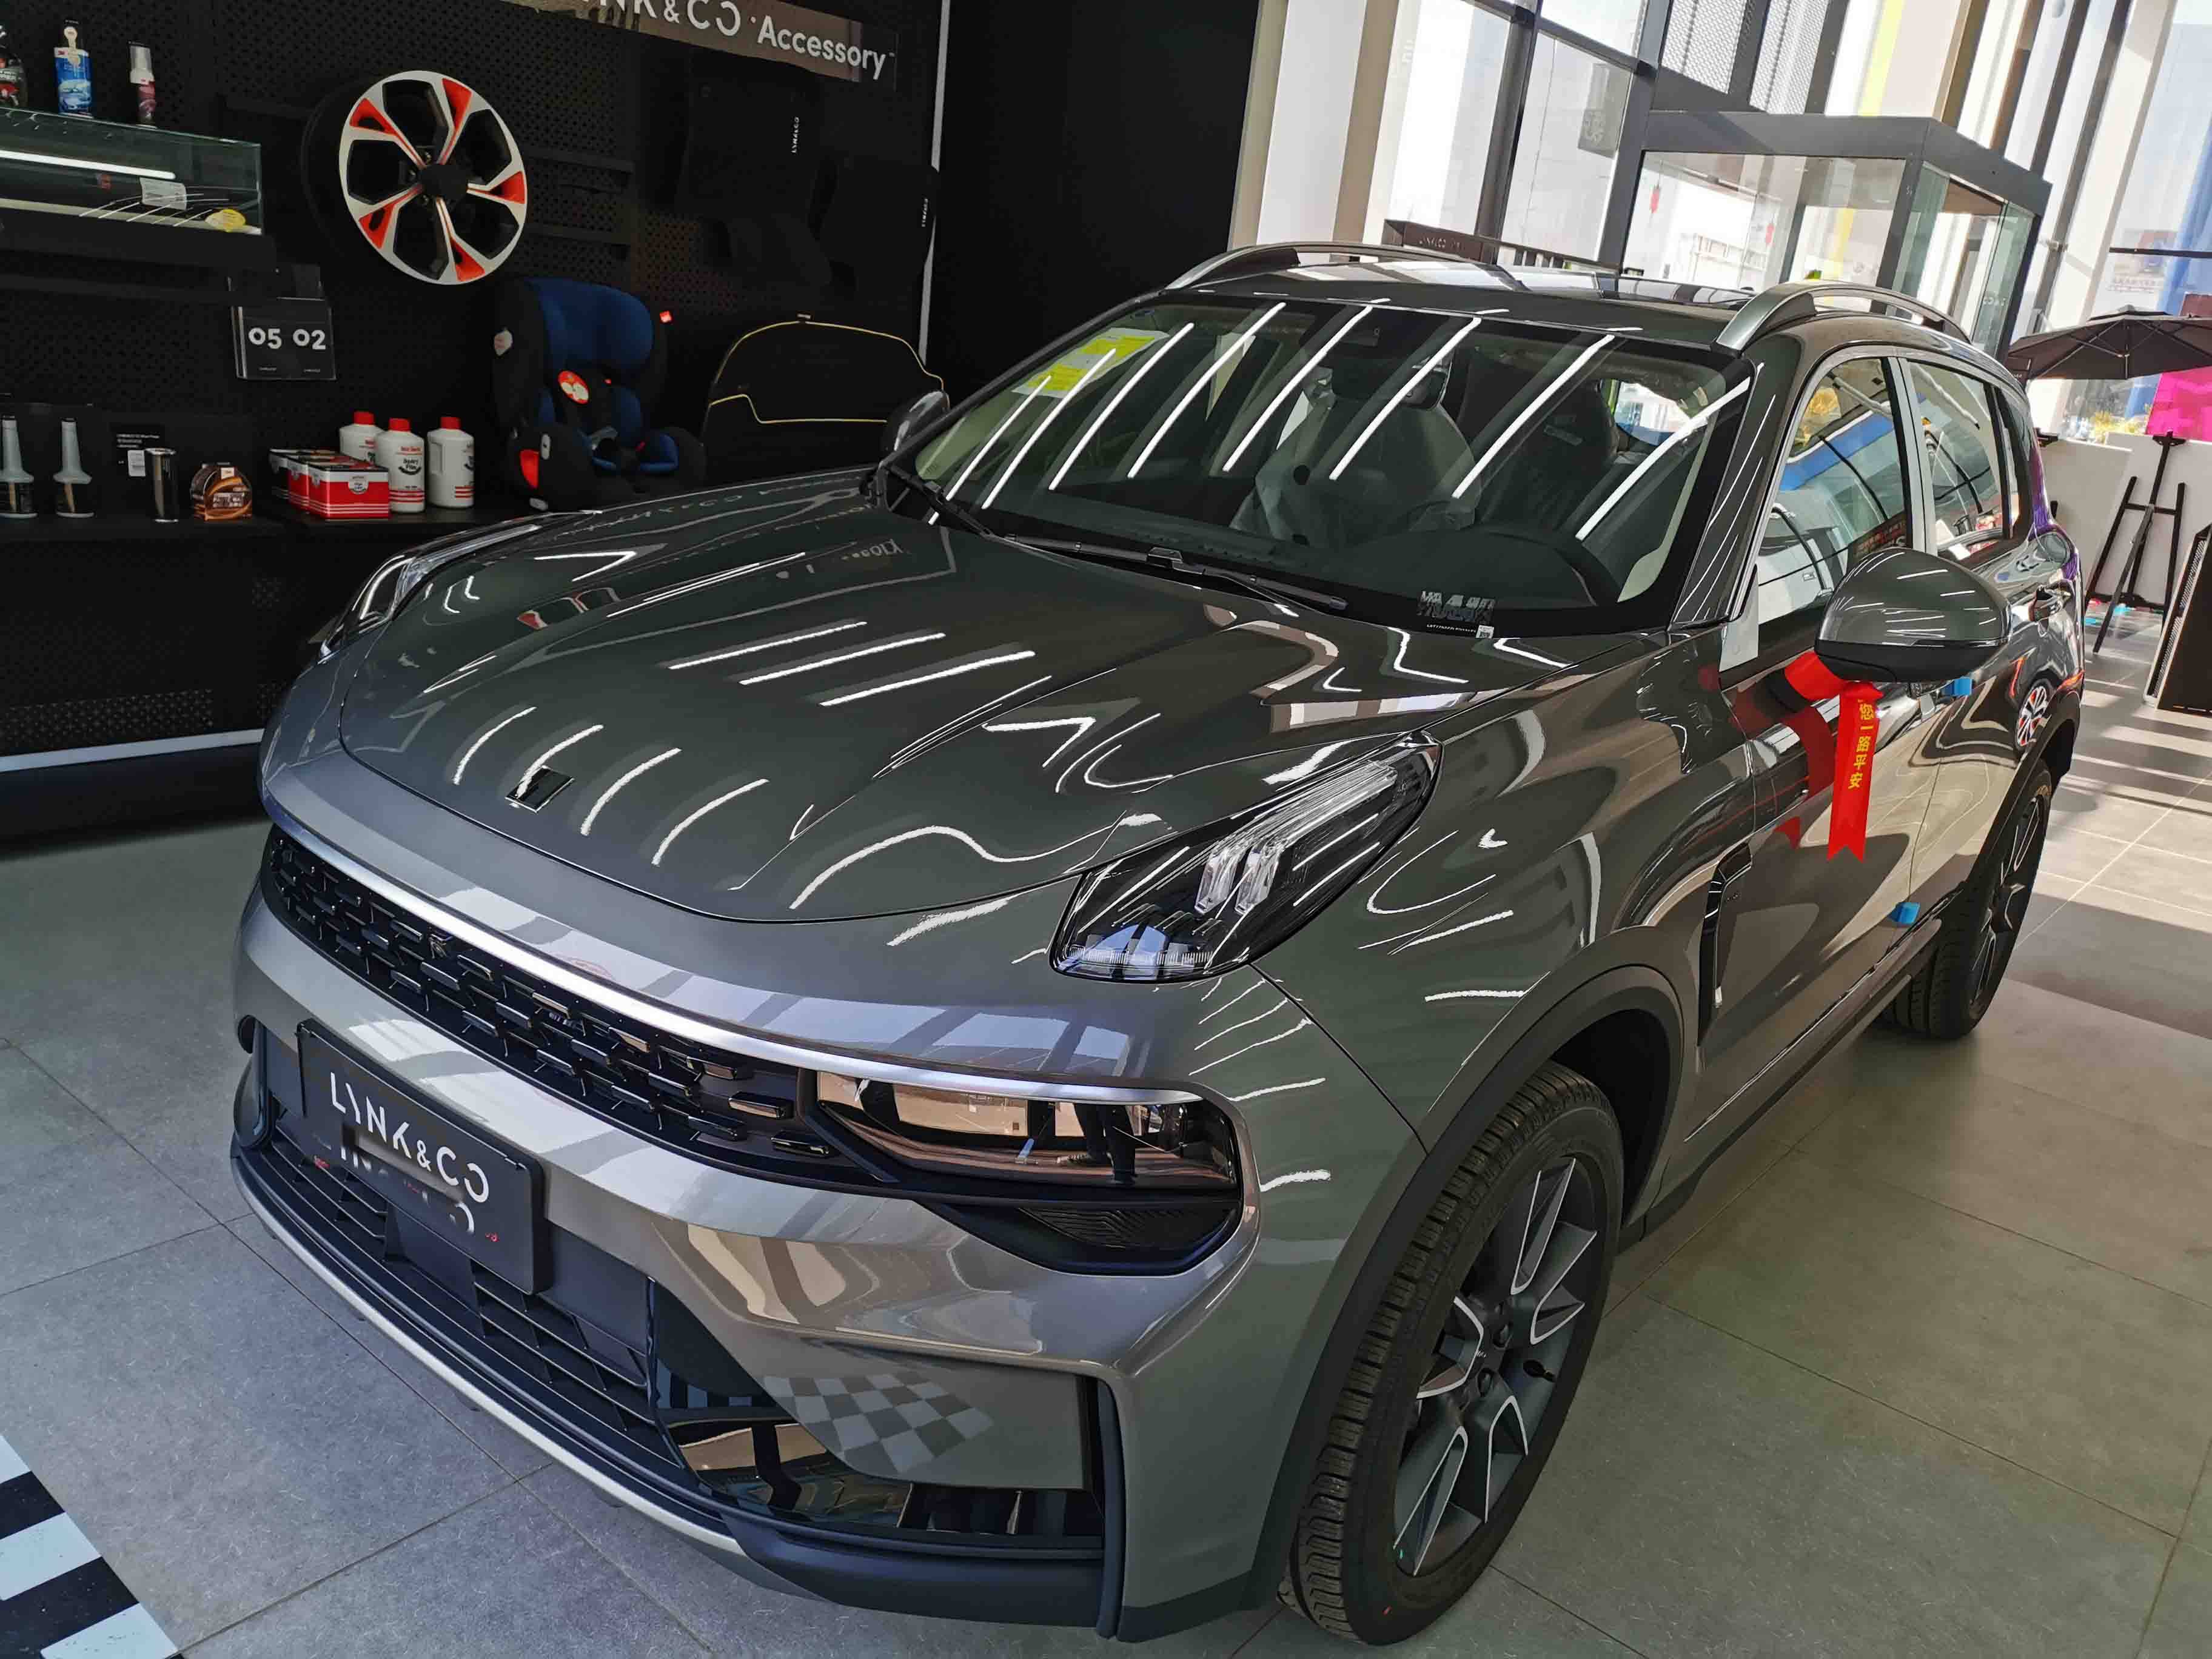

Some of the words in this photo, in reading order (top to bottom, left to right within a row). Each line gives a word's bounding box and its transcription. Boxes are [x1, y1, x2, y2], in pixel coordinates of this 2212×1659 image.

[757, 15, 886, 80] Accessory
[248, 327, 282, 349] 05
[292, 329, 326, 350] 02
[1848, 699, 1874, 789] 您一路平安
[330, 1071, 489, 1203] LYNK&CO
